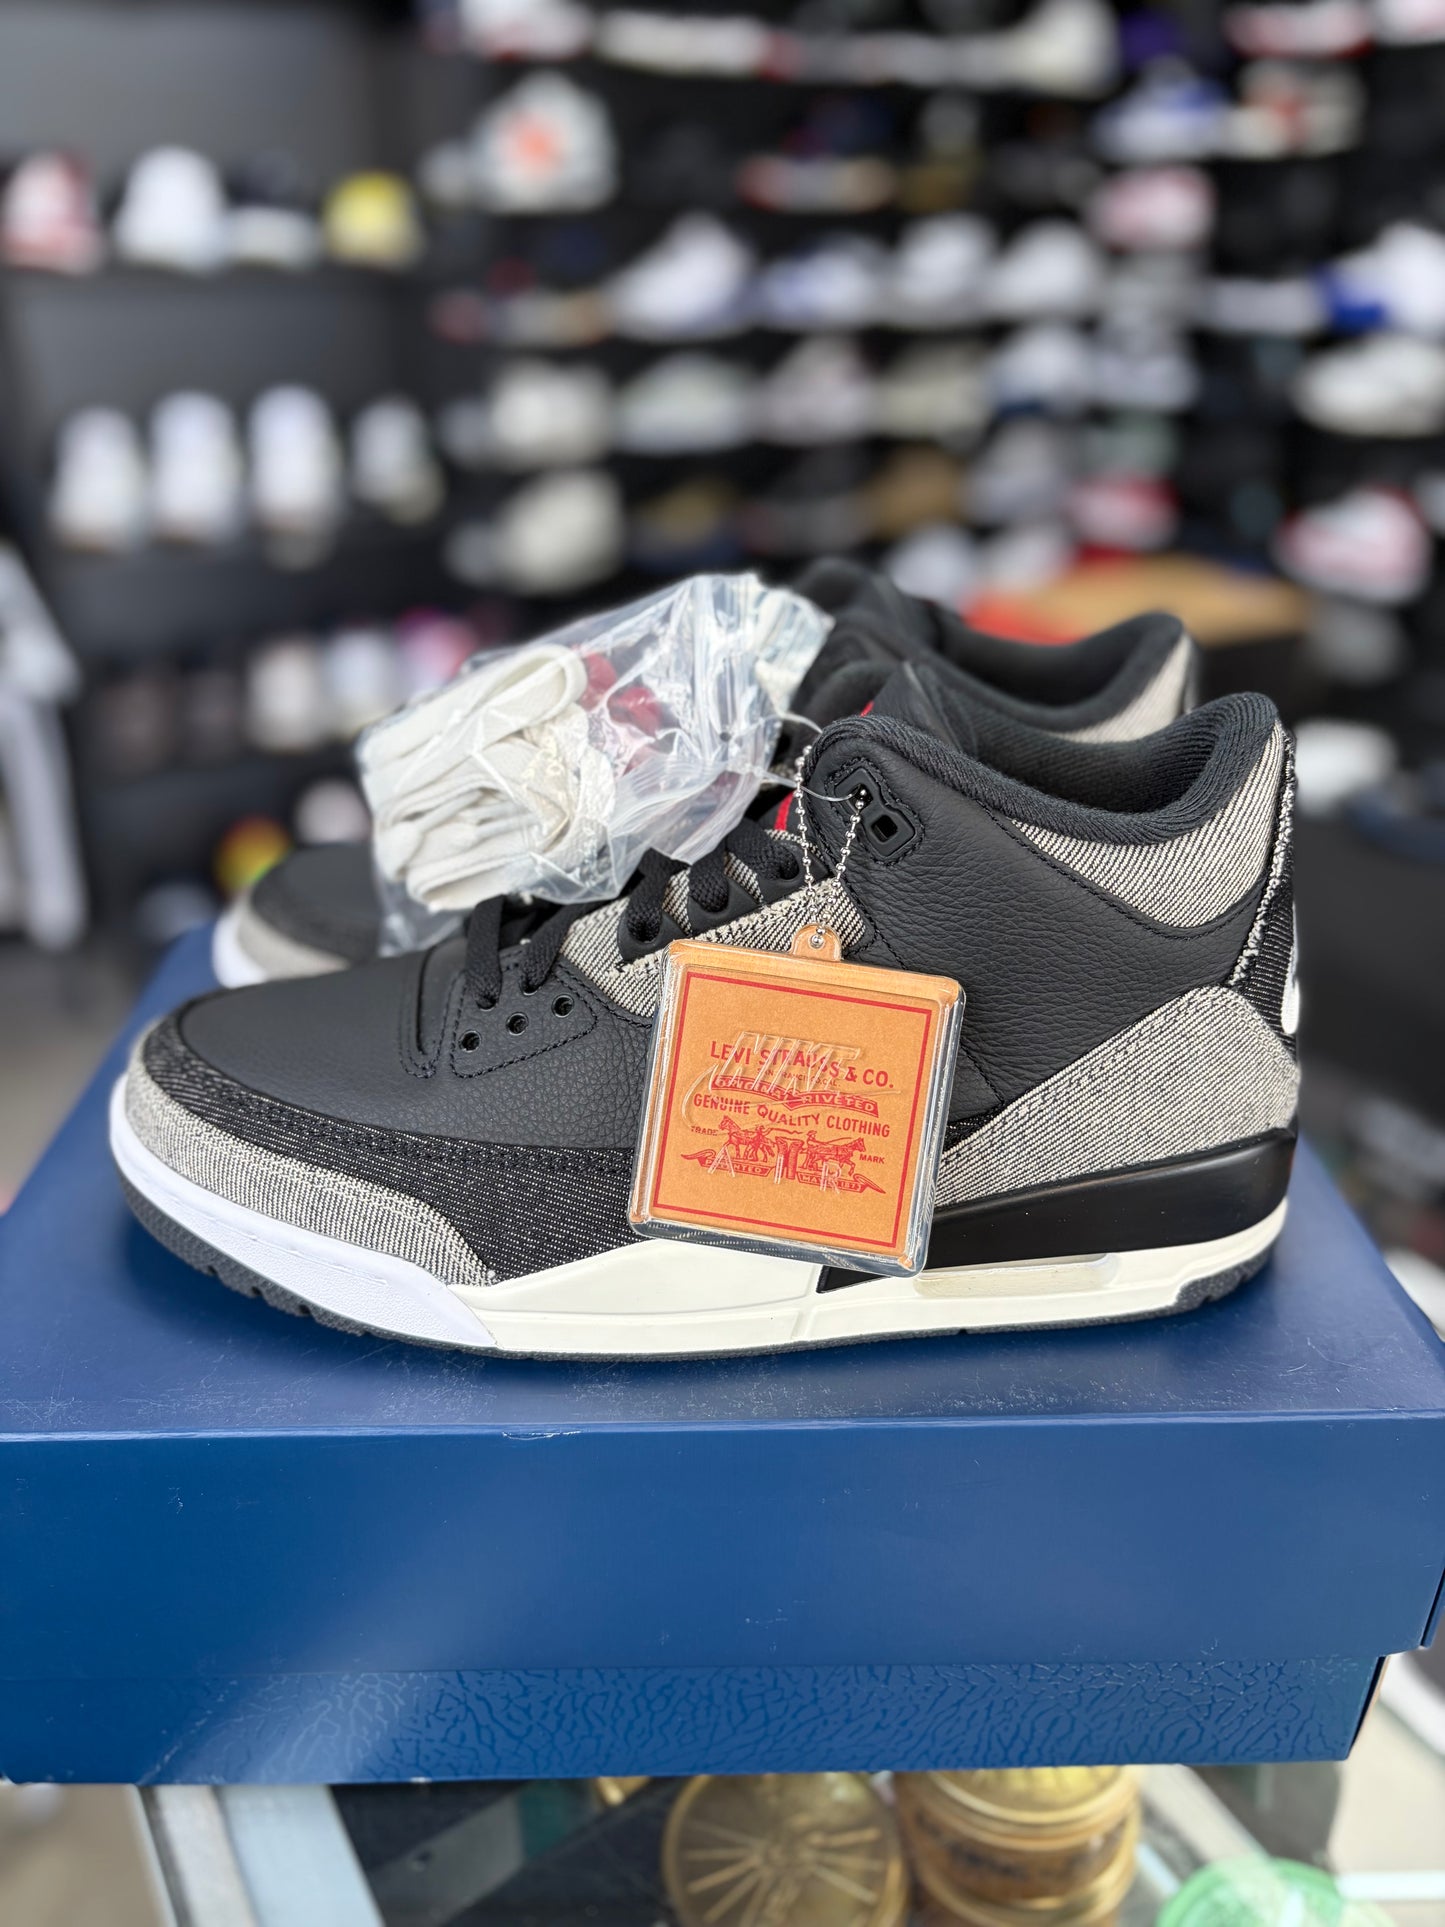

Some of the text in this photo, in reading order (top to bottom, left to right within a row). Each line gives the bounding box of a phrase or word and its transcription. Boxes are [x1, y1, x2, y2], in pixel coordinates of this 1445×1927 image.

[710, 1041, 894, 1089] LEVI STRAUSS & CO.
[714, 1031, 861, 1095] NIKE
[693, 1092, 891, 1138] GENUINE QUALITY CLOTHING
[802, 1094, 875, 1112] RIVETED
[690, 1125, 886, 1165] TRADE MARK
